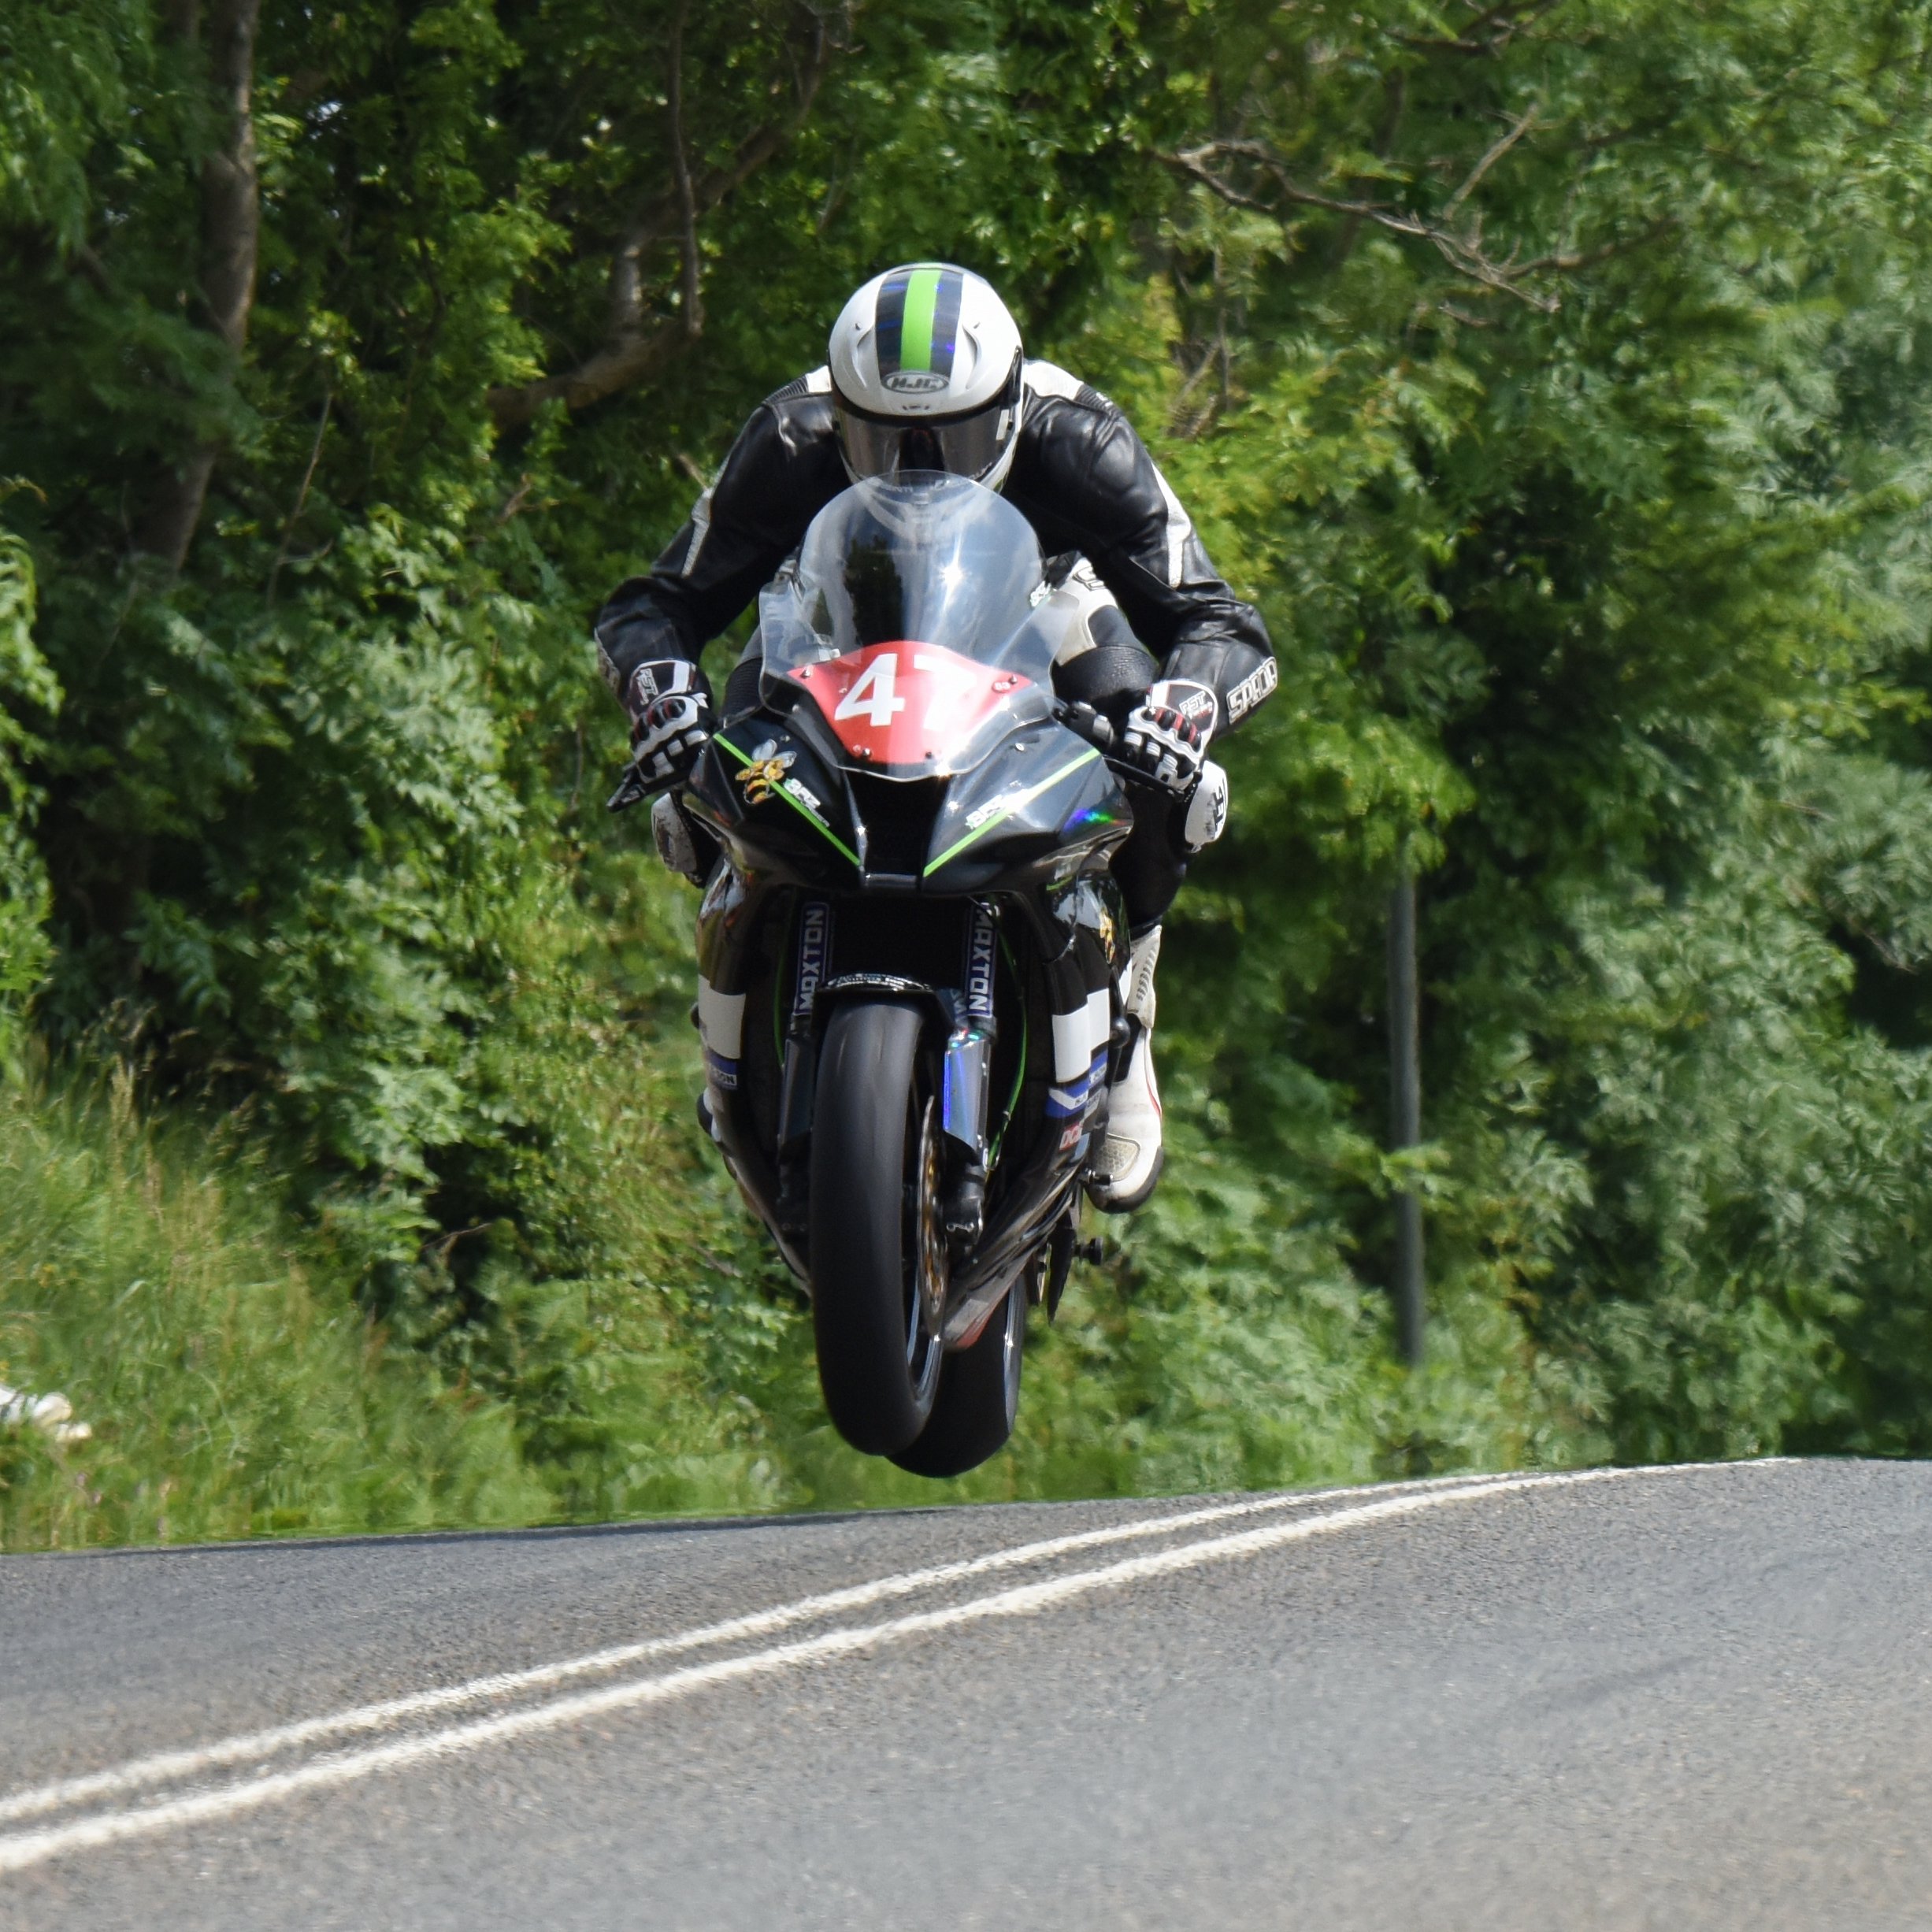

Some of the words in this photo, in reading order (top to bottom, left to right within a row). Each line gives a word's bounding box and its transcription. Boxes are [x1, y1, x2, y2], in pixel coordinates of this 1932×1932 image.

[891, 377, 940, 389] HJC
[834, 653, 975, 732] 47
[1179, 690, 1207, 714] RST
[799, 908, 825, 1010] MAXTON
[968, 908, 993, 1011] MAXTON
